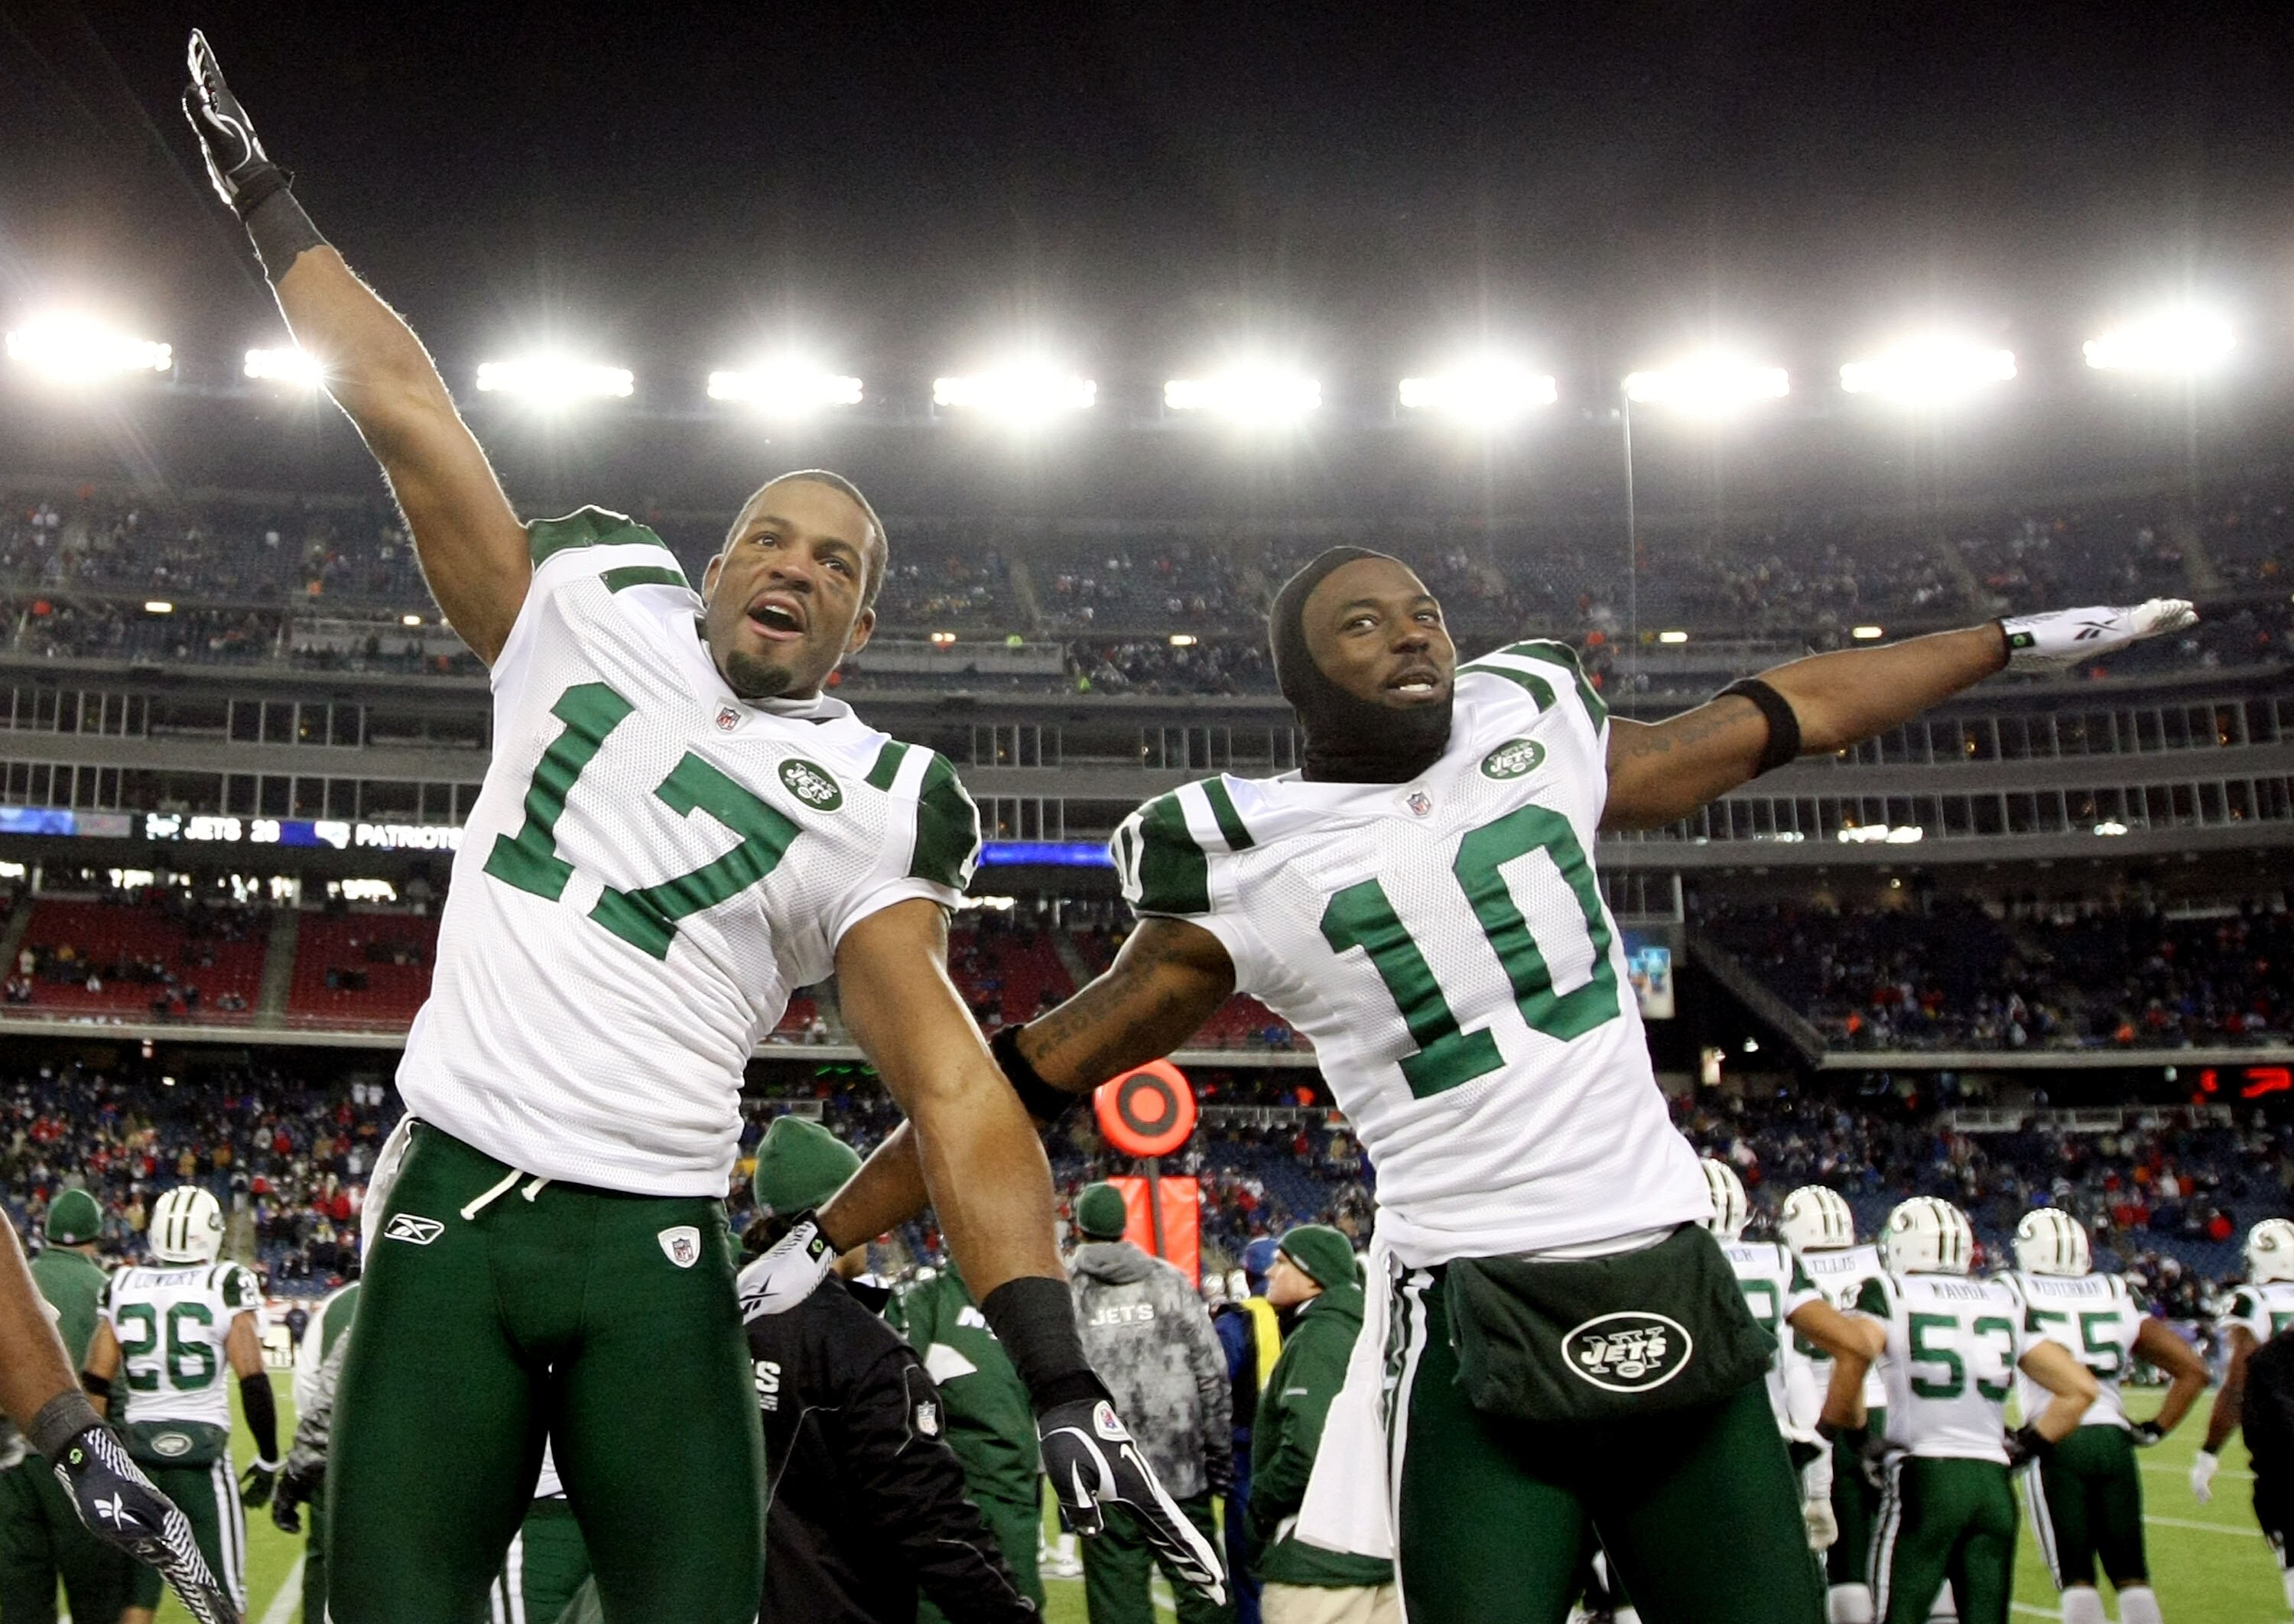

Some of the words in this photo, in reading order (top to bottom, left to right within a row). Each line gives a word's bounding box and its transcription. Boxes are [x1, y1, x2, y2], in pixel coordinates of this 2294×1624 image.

[1490, 746, 1535, 774] JETS
[786, 768, 833, 801] JETS
[184, 816, 242, 841] JETS
[483, 681, 803, 961] 17
[1320, 804, 1622, 1099] 10
[1088, 1303, 1155, 1327] JETS
[117, 1301, 216, 1392] 26
[1581, 1337, 1667, 1366] JETS
[1909, 1311, 2015, 1402] 53
